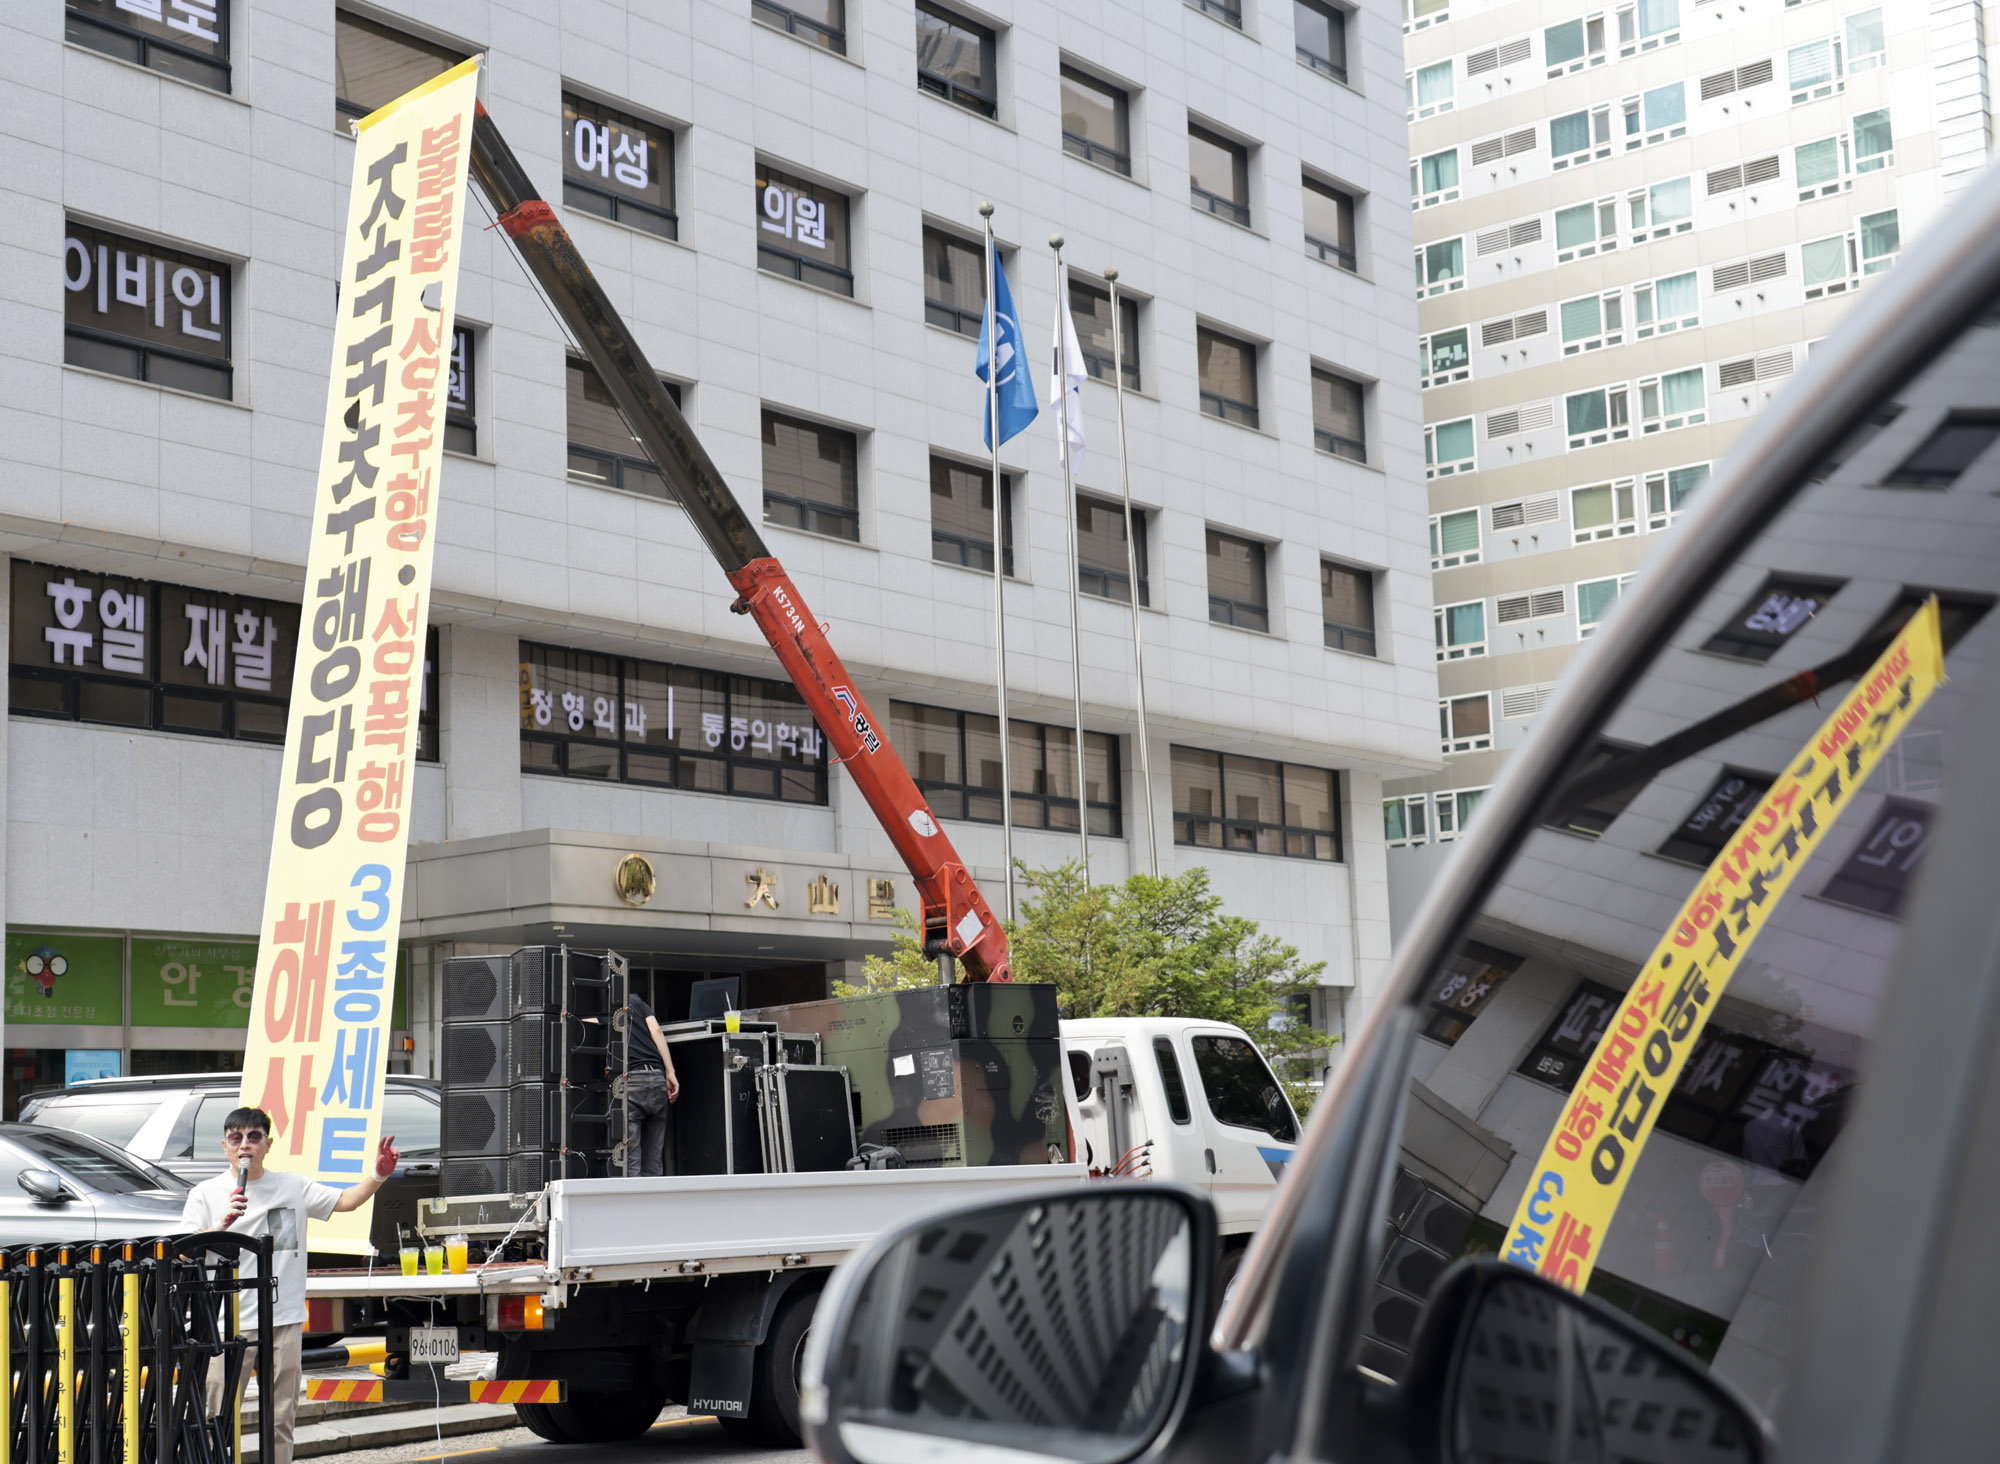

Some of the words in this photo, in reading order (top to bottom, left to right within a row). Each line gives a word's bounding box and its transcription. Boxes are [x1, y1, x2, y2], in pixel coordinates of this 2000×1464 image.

[574, 118, 649, 189] 여성
[762, 184, 826, 249] 의원
[65, 237, 222, 342] 이비인
[773, 586, 806, 633] KS734N
[45, 578, 145, 675] 휴엘
[184, 603, 278, 692] 재활
[530, 687, 648, 738] 정형외과
[703, 712, 823, 760] 통증의학과
[855, 713, 881, 755] 광림
[61, 1006, 96, 1019] 전문점
[693, 1398, 743, 1412] HYUNDAI
